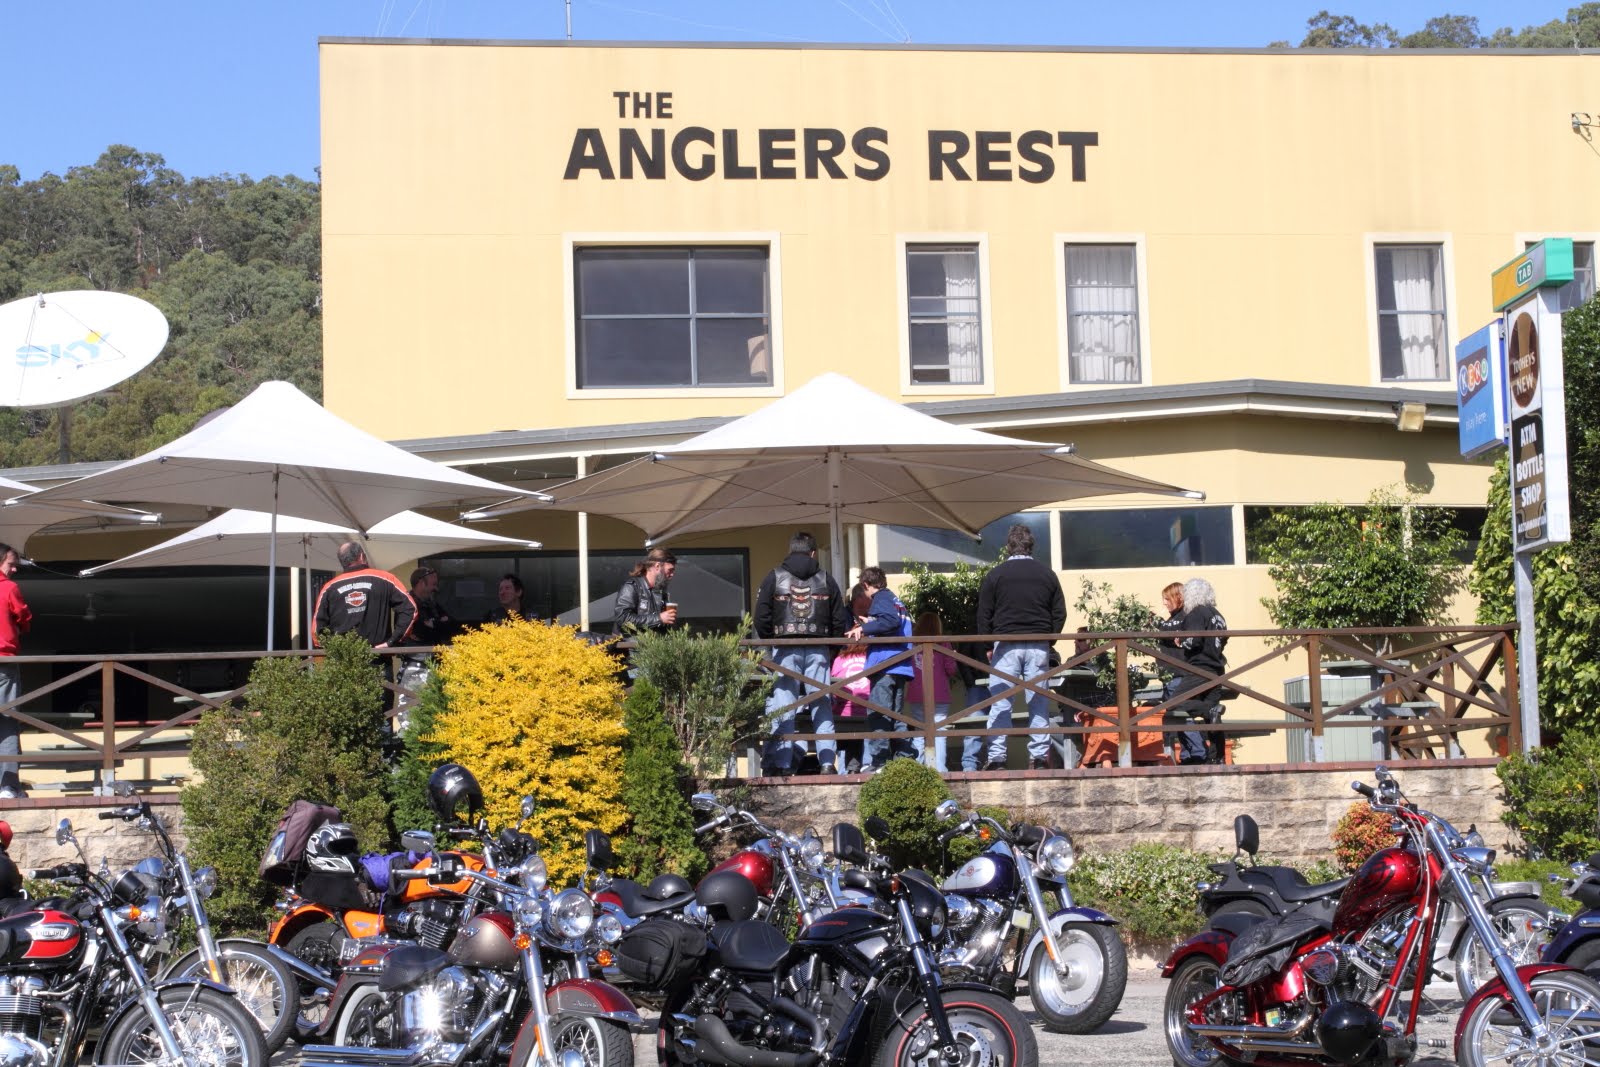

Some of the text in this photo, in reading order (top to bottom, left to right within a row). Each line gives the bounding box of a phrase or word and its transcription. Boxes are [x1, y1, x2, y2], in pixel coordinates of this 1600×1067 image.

[613, 91, 673, 119] THE
[563, 125, 1099, 184] ANGLERS REST
[1518, 264, 1532, 282] TAB
[1460, 360, 1487, 393] KENO
[1516, 372, 1534, 396] NEW
[1520, 423, 1537, 447] ATM
[1516, 453, 1544, 482] BOTTLE
[1521, 482, 1542, 507] SHOP
